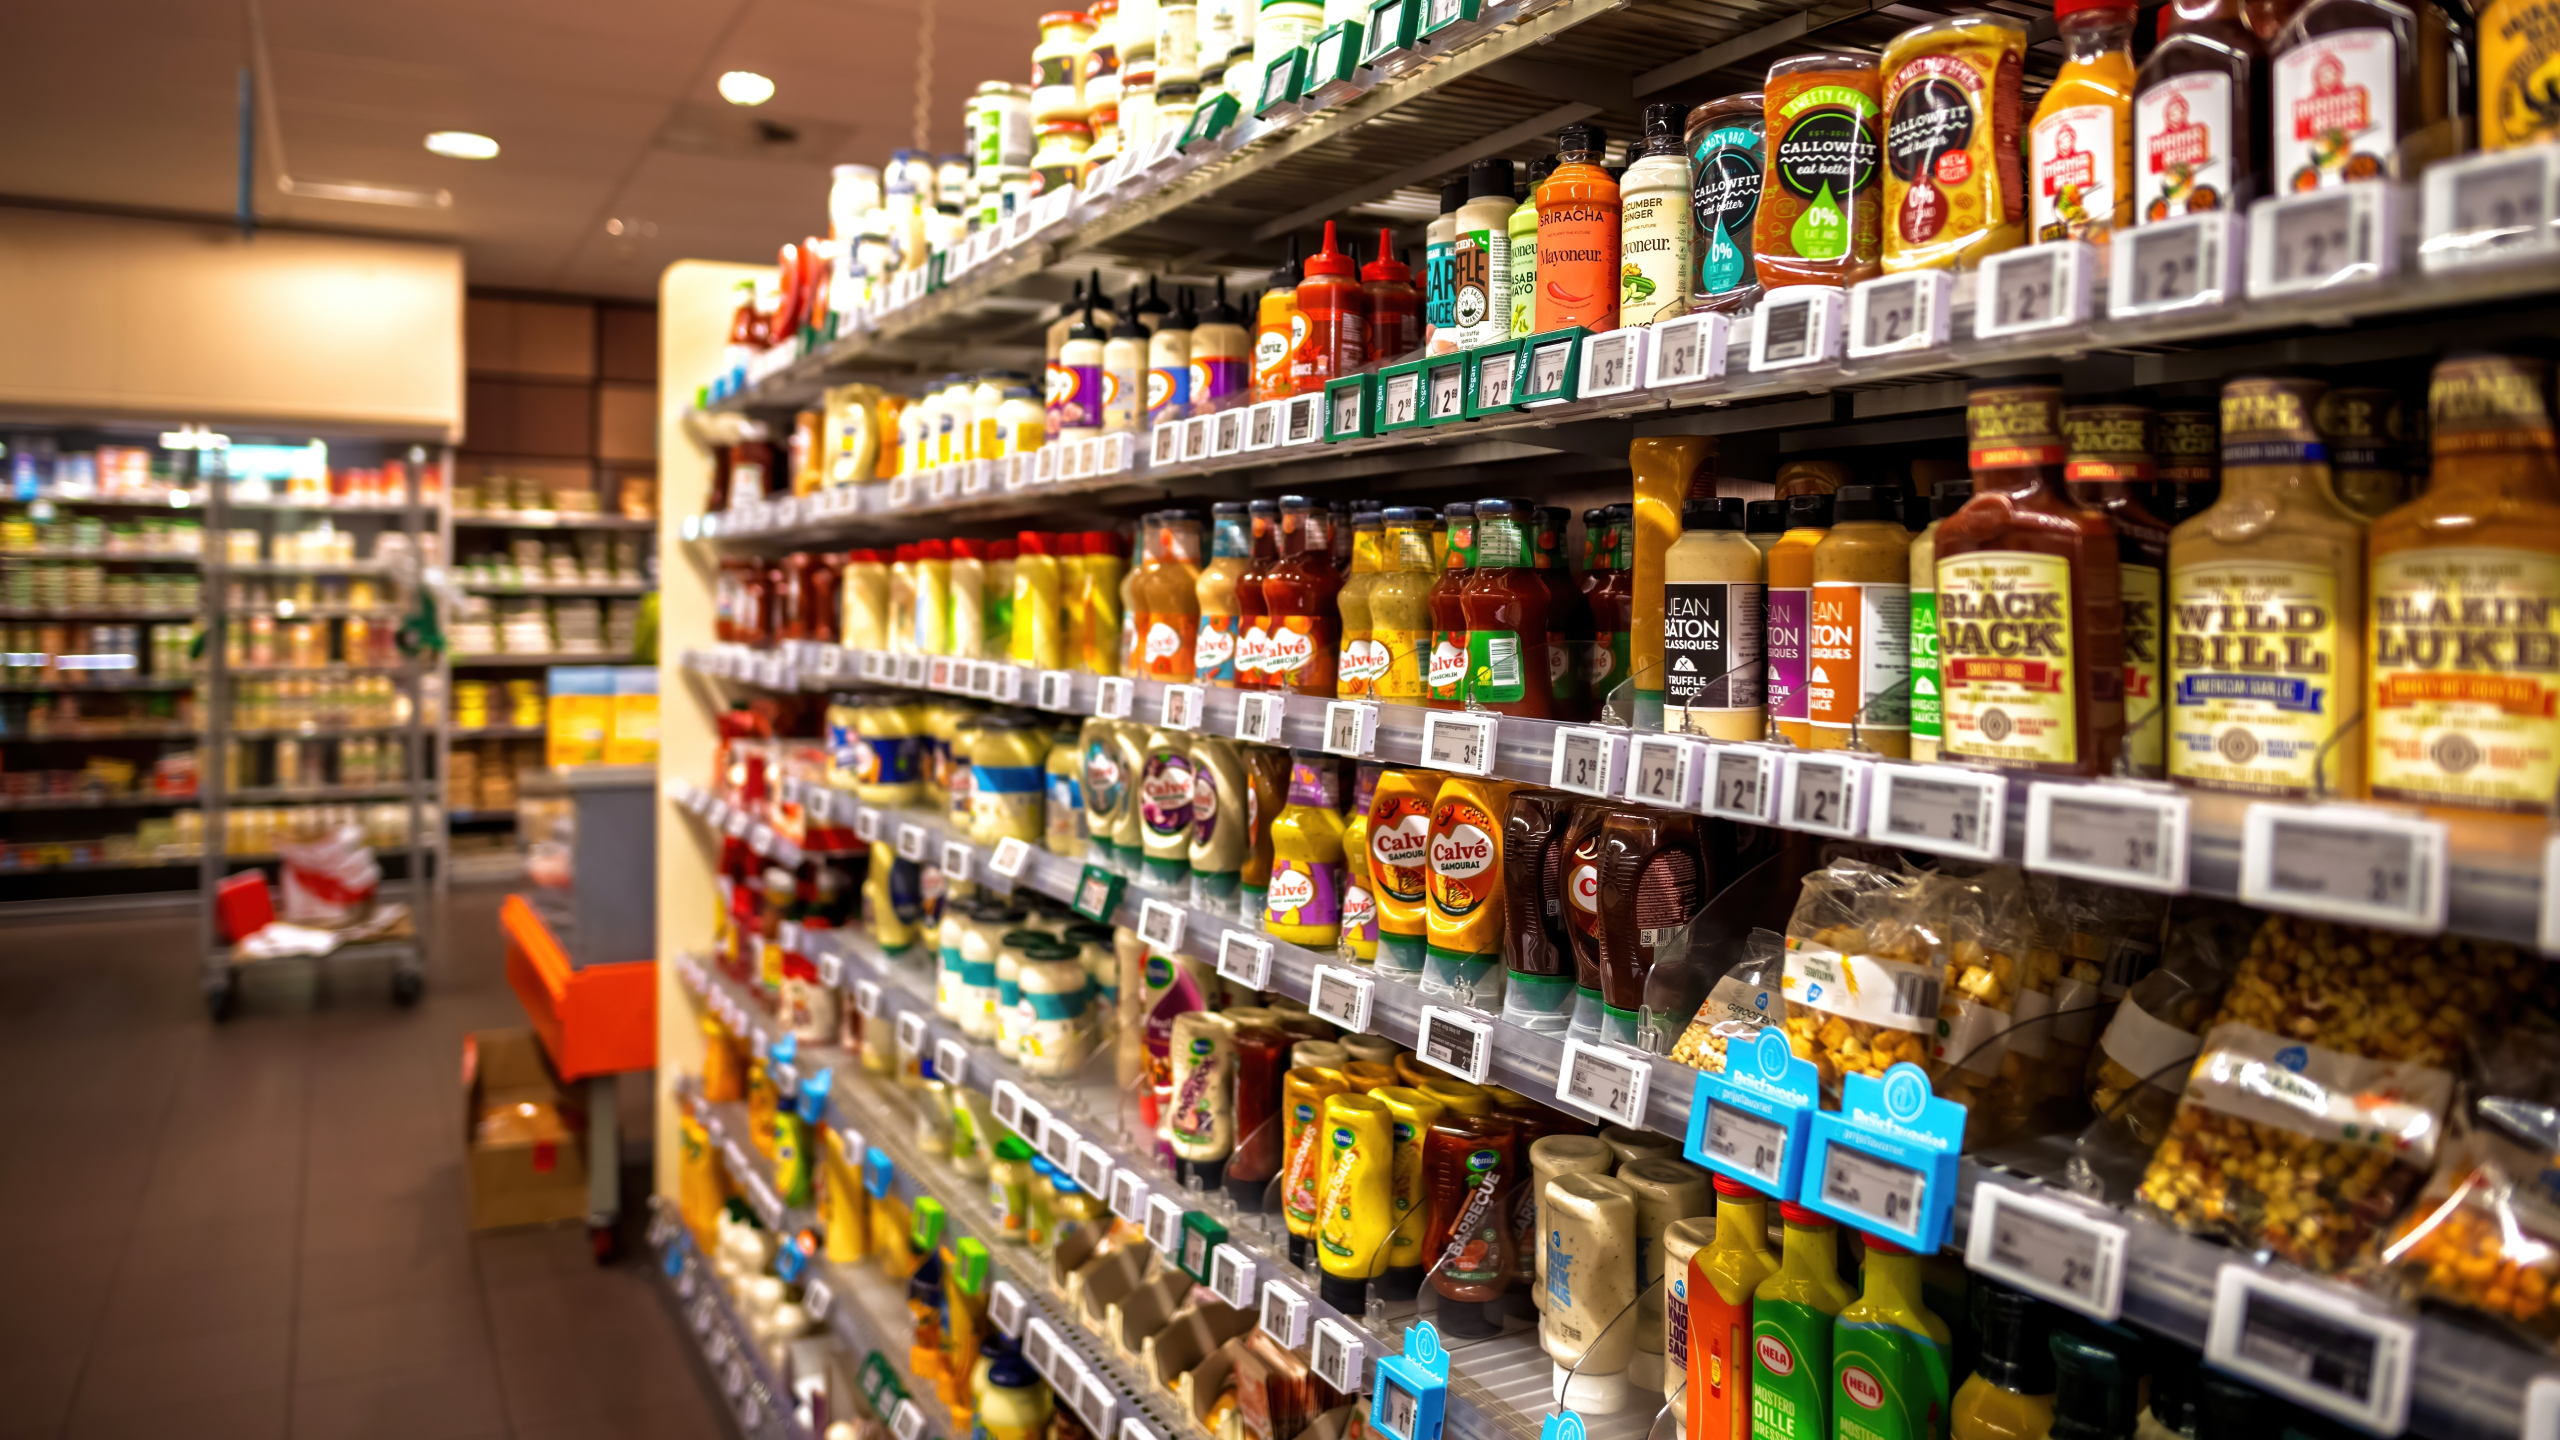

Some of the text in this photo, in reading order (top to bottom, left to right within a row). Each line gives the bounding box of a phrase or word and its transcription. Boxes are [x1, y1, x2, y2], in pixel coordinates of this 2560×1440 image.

[1890, 106, 1968, 138] CALLOWFIT
[1729, 132, 1745, 144] BBQ
[1780, 141, 1876, 156] CALLOWFIT
[1796, 164, 1816, 175] eat
[1694, 174, 1760, 198] CALLOWFIT
[1624, 209, 1654, 223] GINGER
[1703, 200, 1744, 216] eat better
[1808, 206, 1838, 226] 0%
[1540, 210, 1604, 227] SRIRACHA
[1712, 243, 1732, 262] 0%
[1427, 302, 1451, 325] AUCE
[1516, 352, 1528, 382] Vegan
[1468, 366, 1477, 396] Vegan
[2071, 433, 2146, 452] JACK
[1668, 598, 1710, 616] JEAN
[1942, 592, 2064, 620] BLACK
[2174, 604, 2328, 632] WILD
[1665, 618, 1720, 638] BÂTON
[1665, 640, 1720, 650] CLASSIQUES
[1942, 622, 2065, 656] JACK
[2174, 636, 2328, 674] BILL
[2378, 629, 2558, 669] LUKE
[1668, 676, 1706, 686] TRUFFLE
[1670, 686, 1702, 696] SAUCE
[1146, 779, 1190, 795] Calvé
[1434, 838, 1488, 862] Calvé
[1441, 860, 1480, 871] SAMOURAI
[1470, 1156, 1496, 1166] Remia
[1450, 1170, 1500, 1258] BARBECUE
[1762, 1347, 1788, 1366] HELA
[1848, 1379, 1876, 1398] HELA
[1754, 1386, 1796, 1417] MOSTERD
[1754, 1400, 1796, 1436] DILLE
